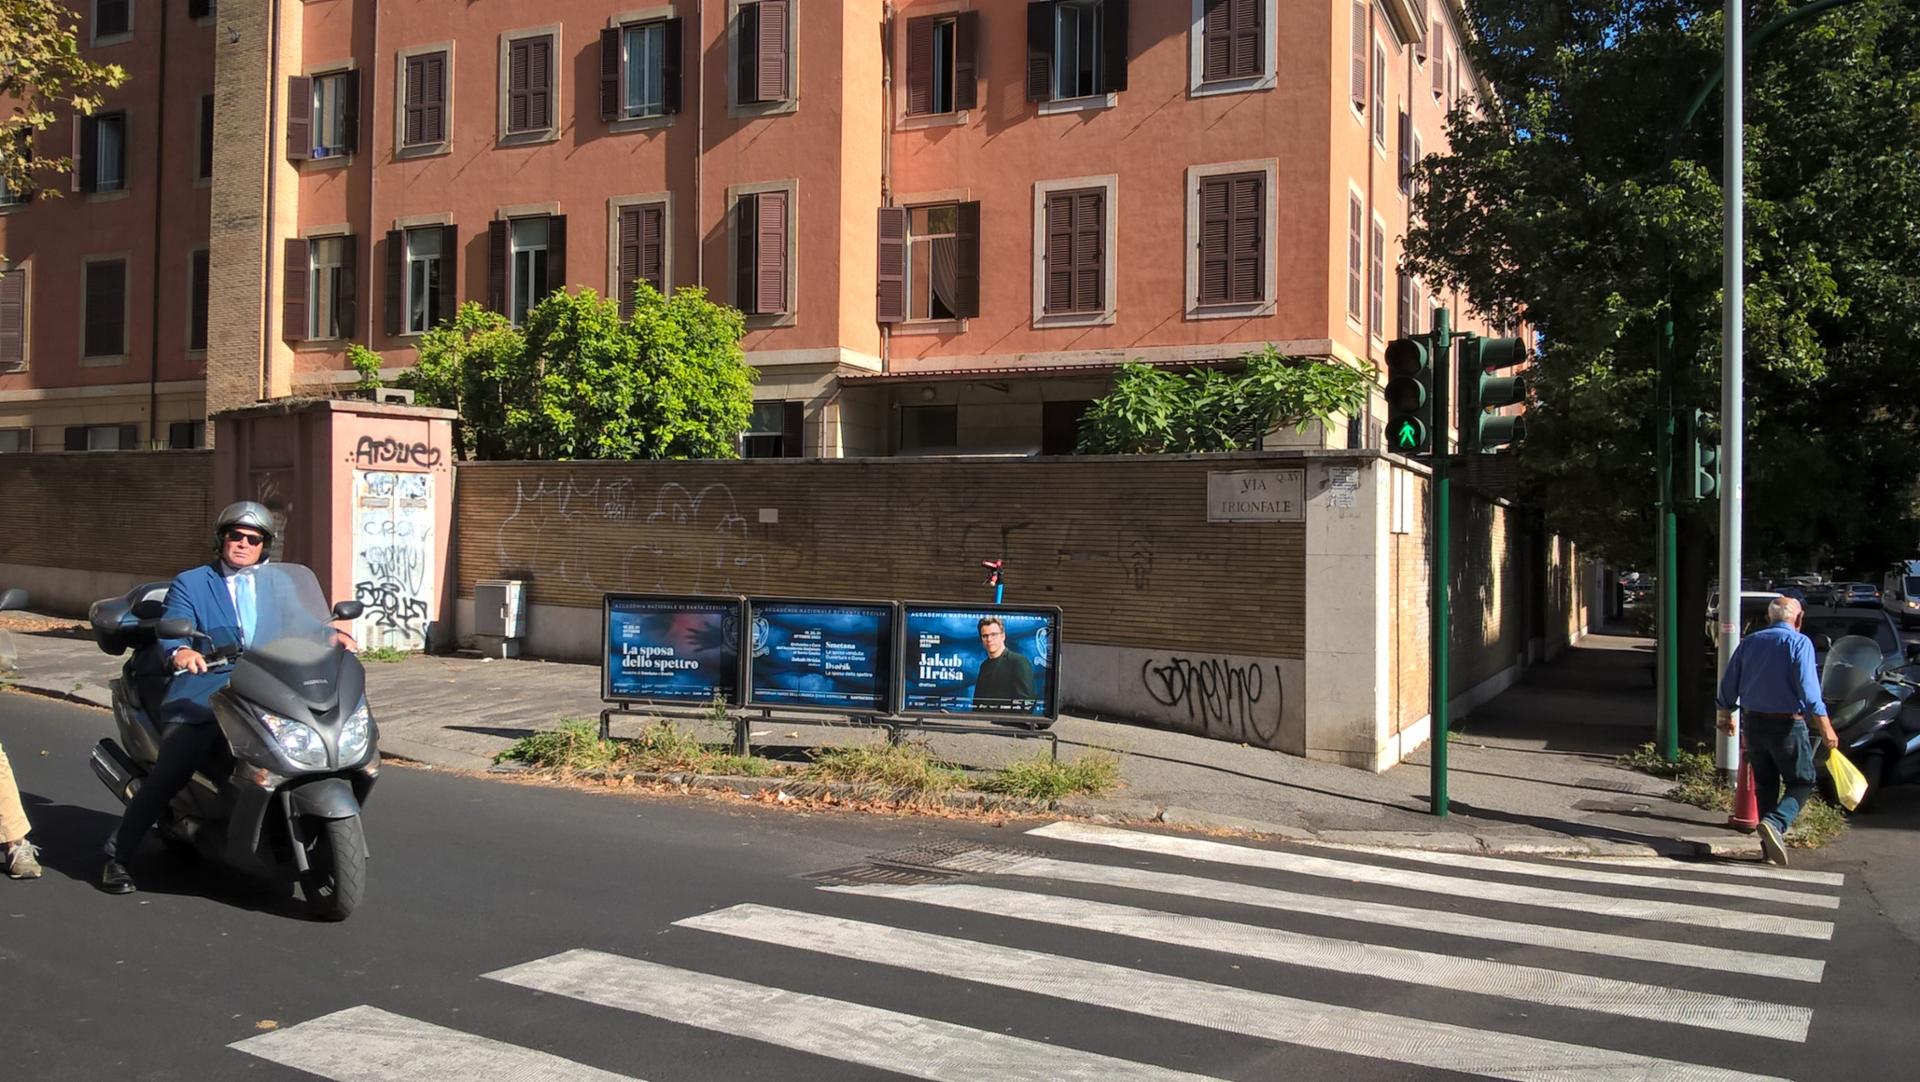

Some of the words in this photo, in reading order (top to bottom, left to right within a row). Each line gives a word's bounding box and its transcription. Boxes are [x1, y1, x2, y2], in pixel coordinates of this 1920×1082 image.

[1242, 479, 1267, 490] VIA
[1221, 501, 1292, 513] TRIONFALE
[623, 643, 639, 655] La
[639, 646, 674, 658] sposa
[825, 641, 856, 650] Smetana
[622, 655, 653, 668] dello
[654, 659, 699, 671] spettro
[918, 653, 962, 668] Jakub
[919, 667, 964, 681] Hrůša
